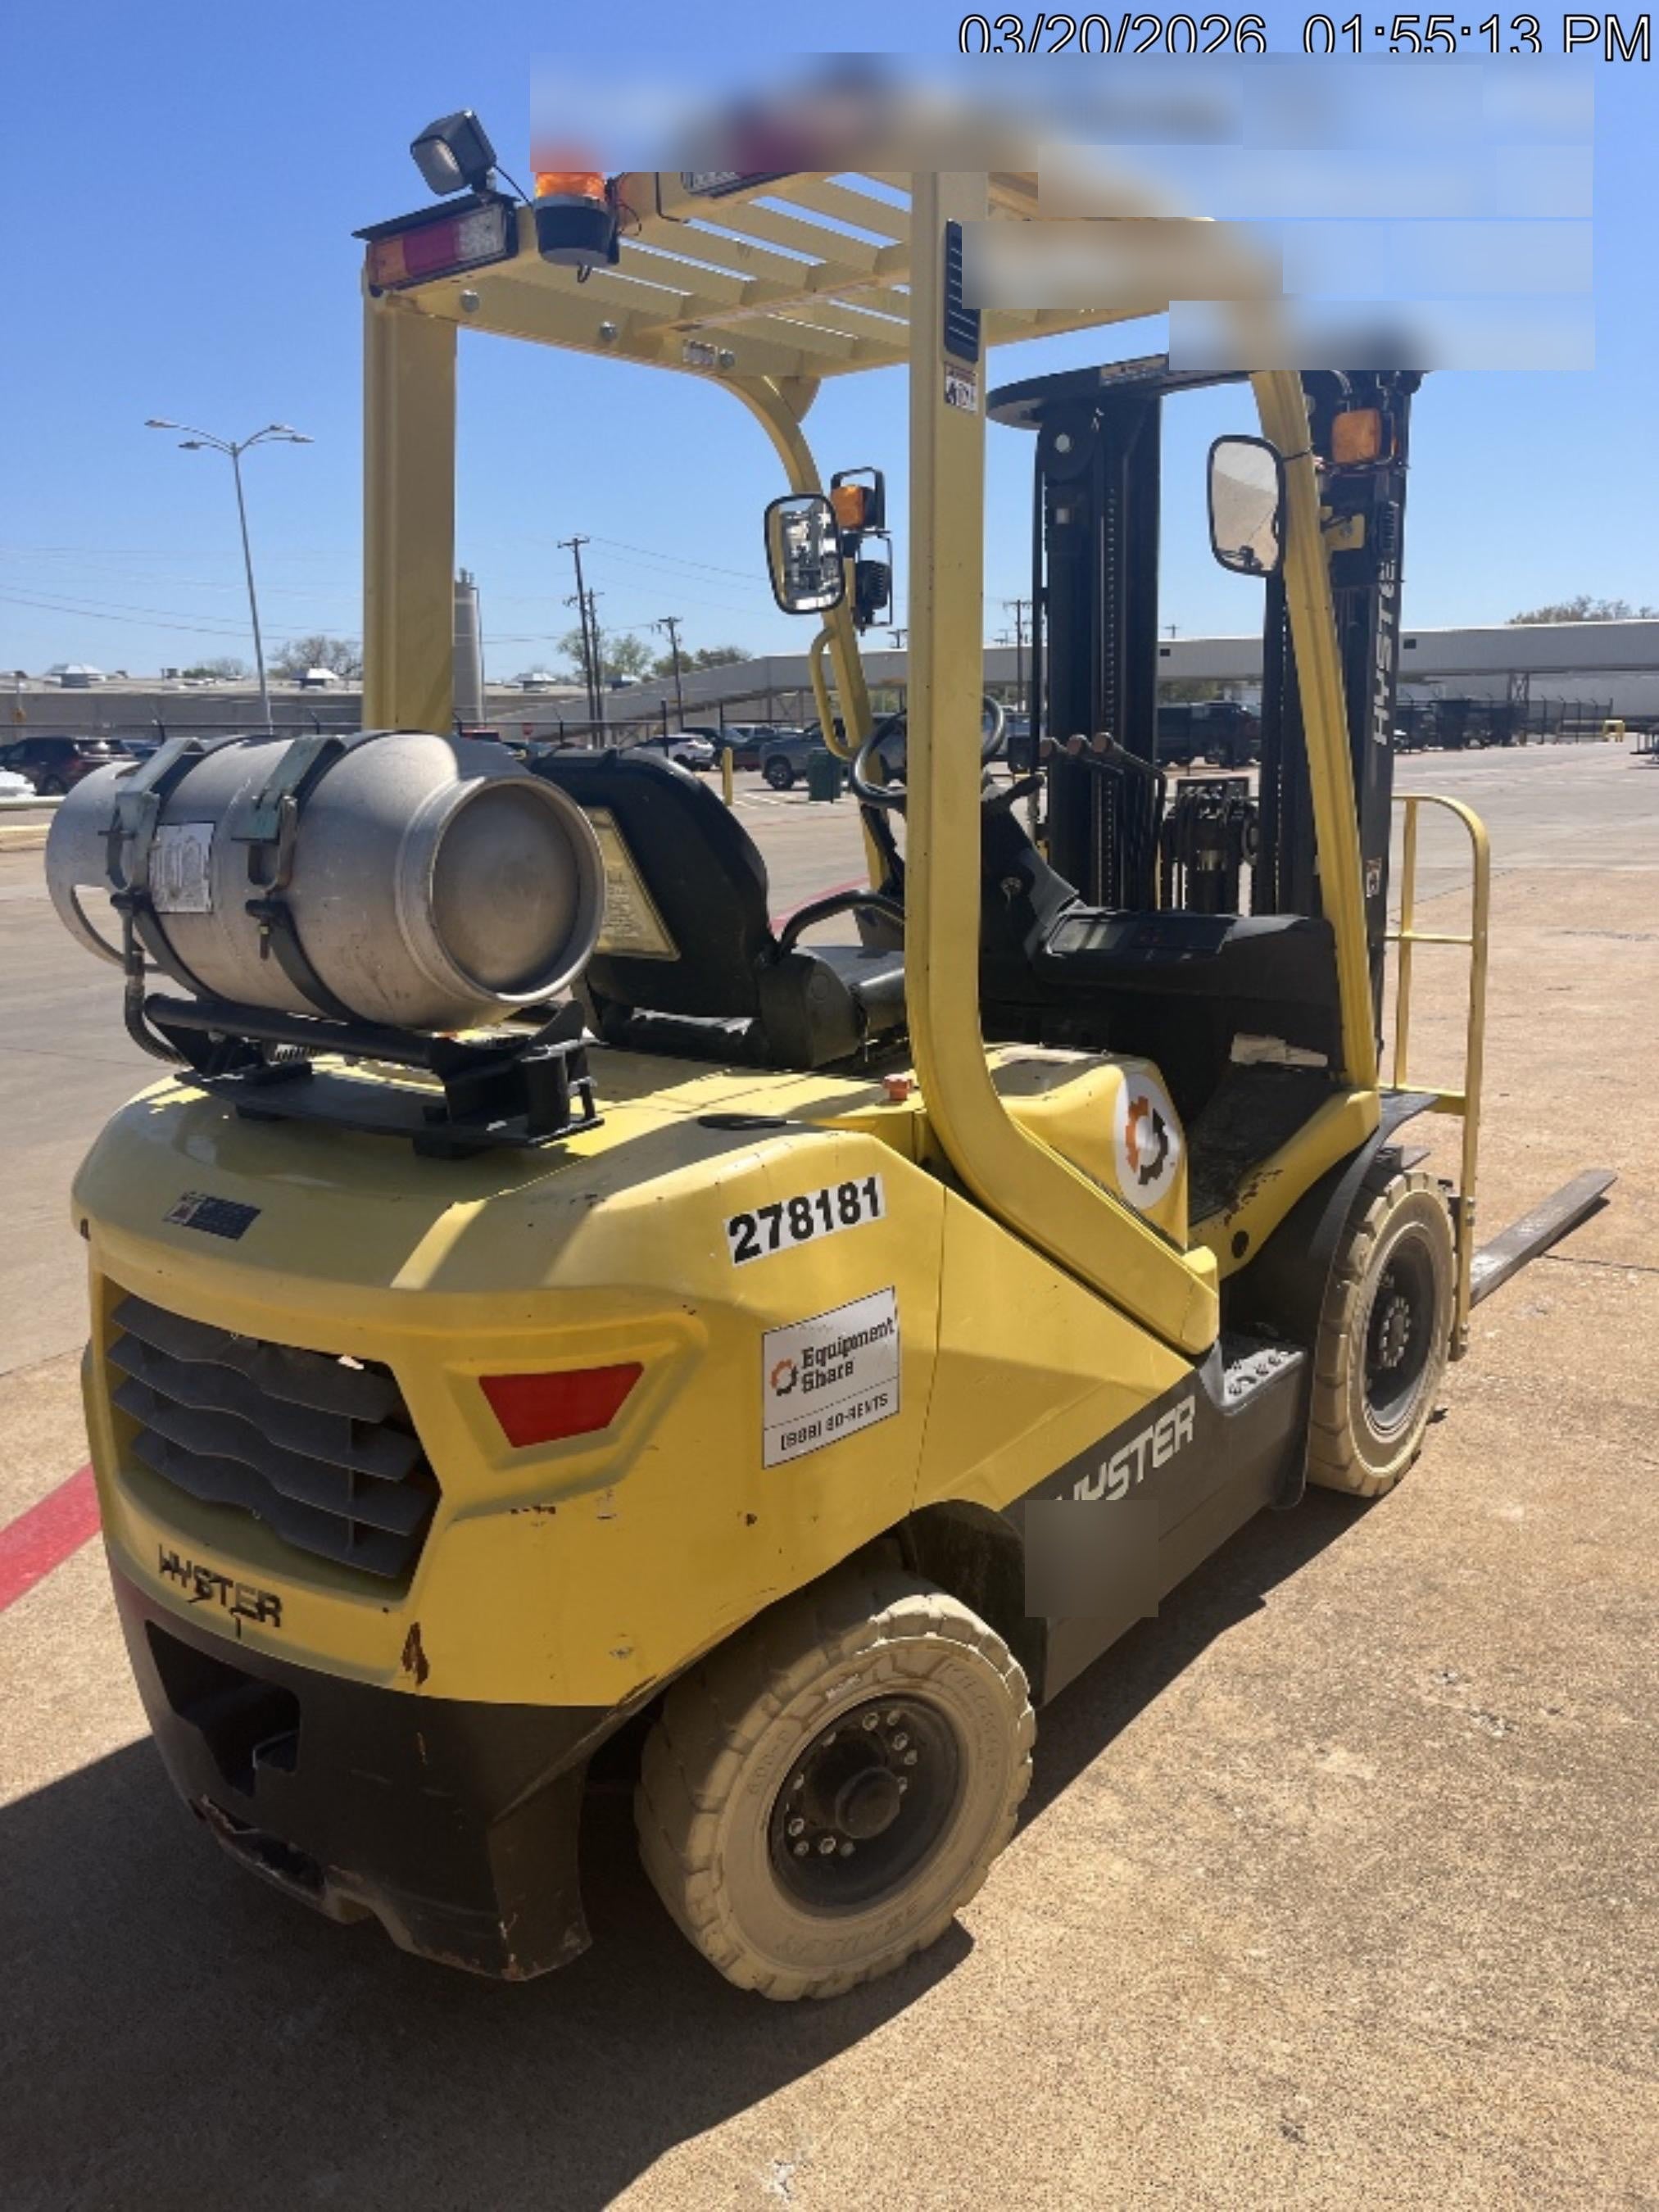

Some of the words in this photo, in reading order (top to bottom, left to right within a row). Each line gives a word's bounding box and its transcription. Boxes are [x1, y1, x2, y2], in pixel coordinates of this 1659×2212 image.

[728, 1176, 880, 1264] 278181
[802, 1317, 895, 1369] Equipment
[802, 1360, 854, 1394] Share
